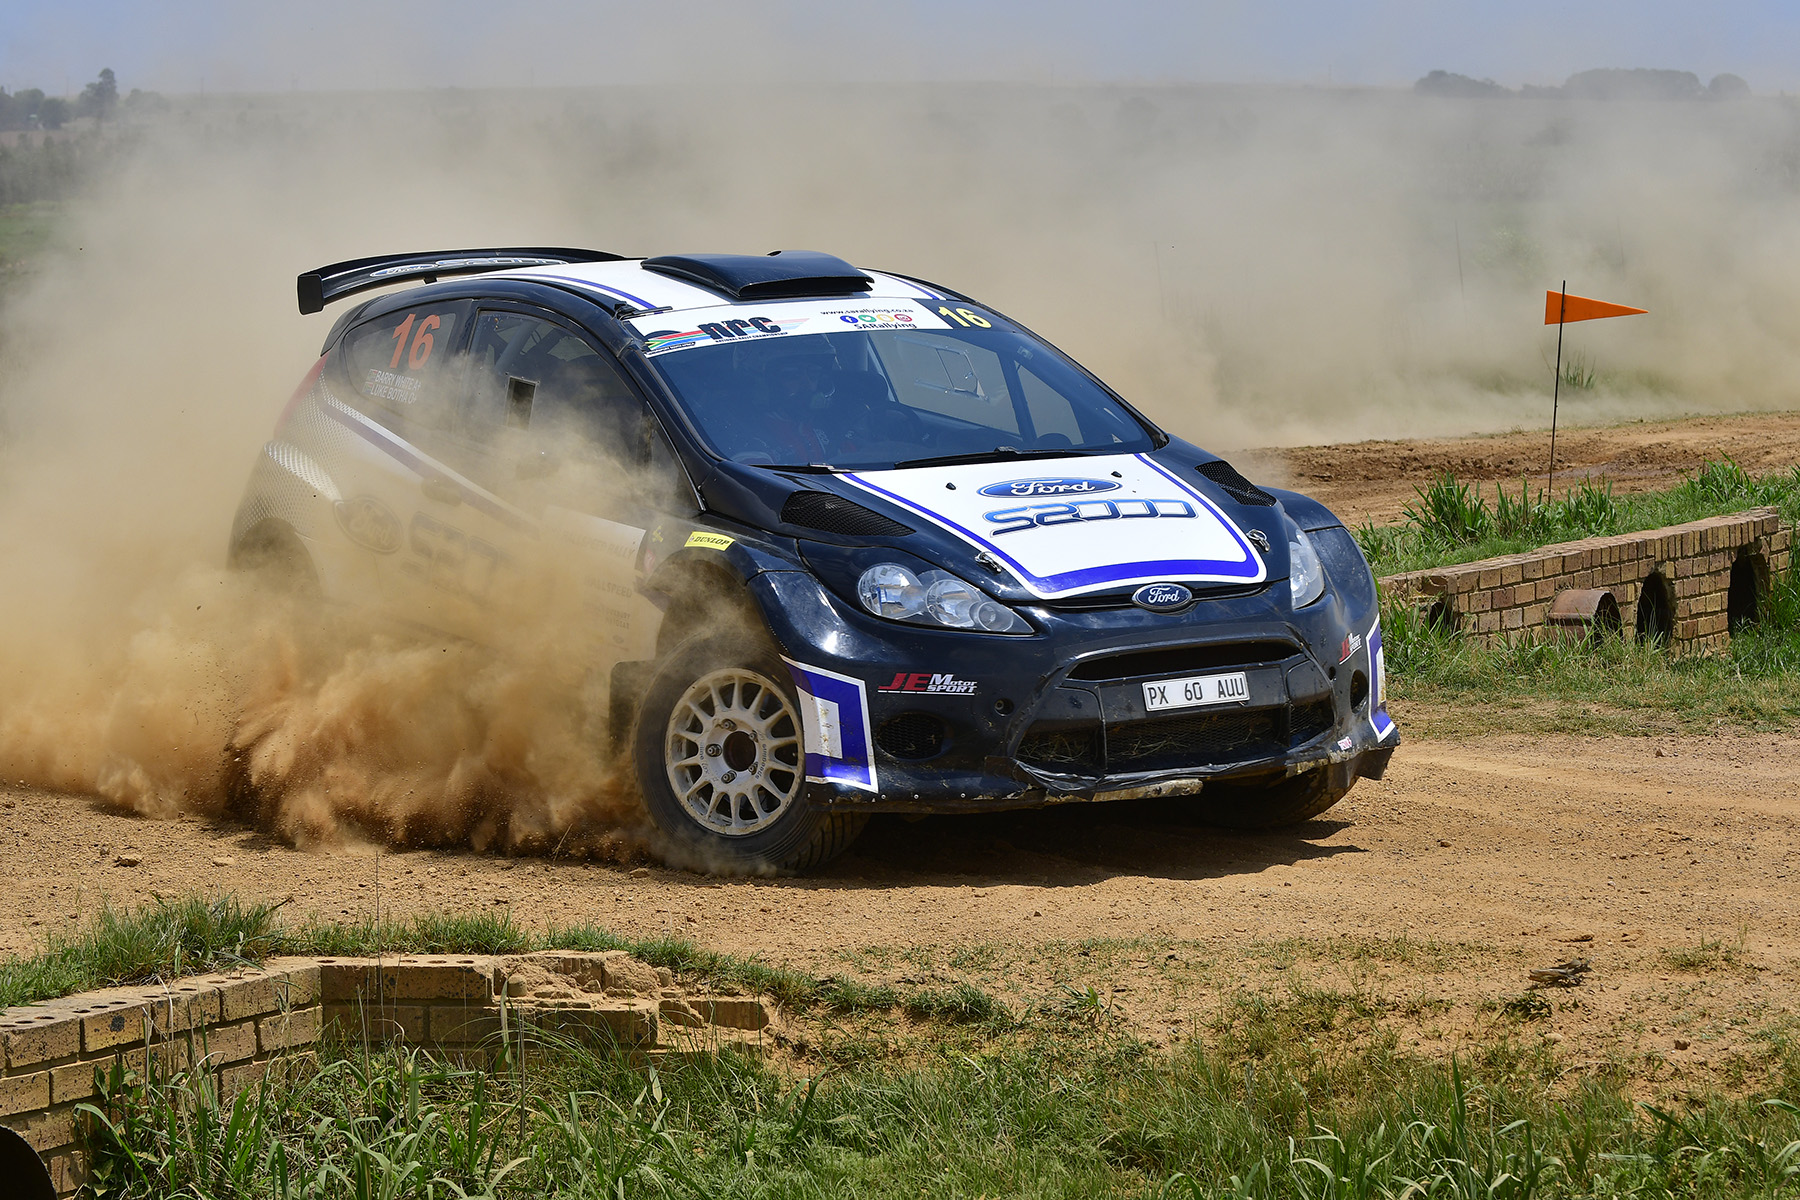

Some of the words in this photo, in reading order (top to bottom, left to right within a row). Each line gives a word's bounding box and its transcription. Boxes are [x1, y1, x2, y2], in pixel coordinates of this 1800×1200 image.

[938, 306, 992, 329] 16
[698, 317, 781, 340] nrc
[389, 313, 441, 370] 16
[374, 370, 397, 386] BARRY
[394, 374, 415, 390] WHITE
[370, 383, 389, 398] LUKE
[386, 386, 409, 403] BOTHA
[1010, 480, 1096, 495] Ford
[982, 498, 1200, 538] S2000
[693, 536, 731, 546] DUNLOP
[1147, 587, 1181, 604] Ford
[878, 673, 932, 691] JE
[929, 673, 978, 686] Motor
[926, 685, 978, 693] SPORT
[1147, 685, 1169, 706] PX
[1184, 681, 1204, 702] 60
[1217, 677, 1245, 699] AUU
